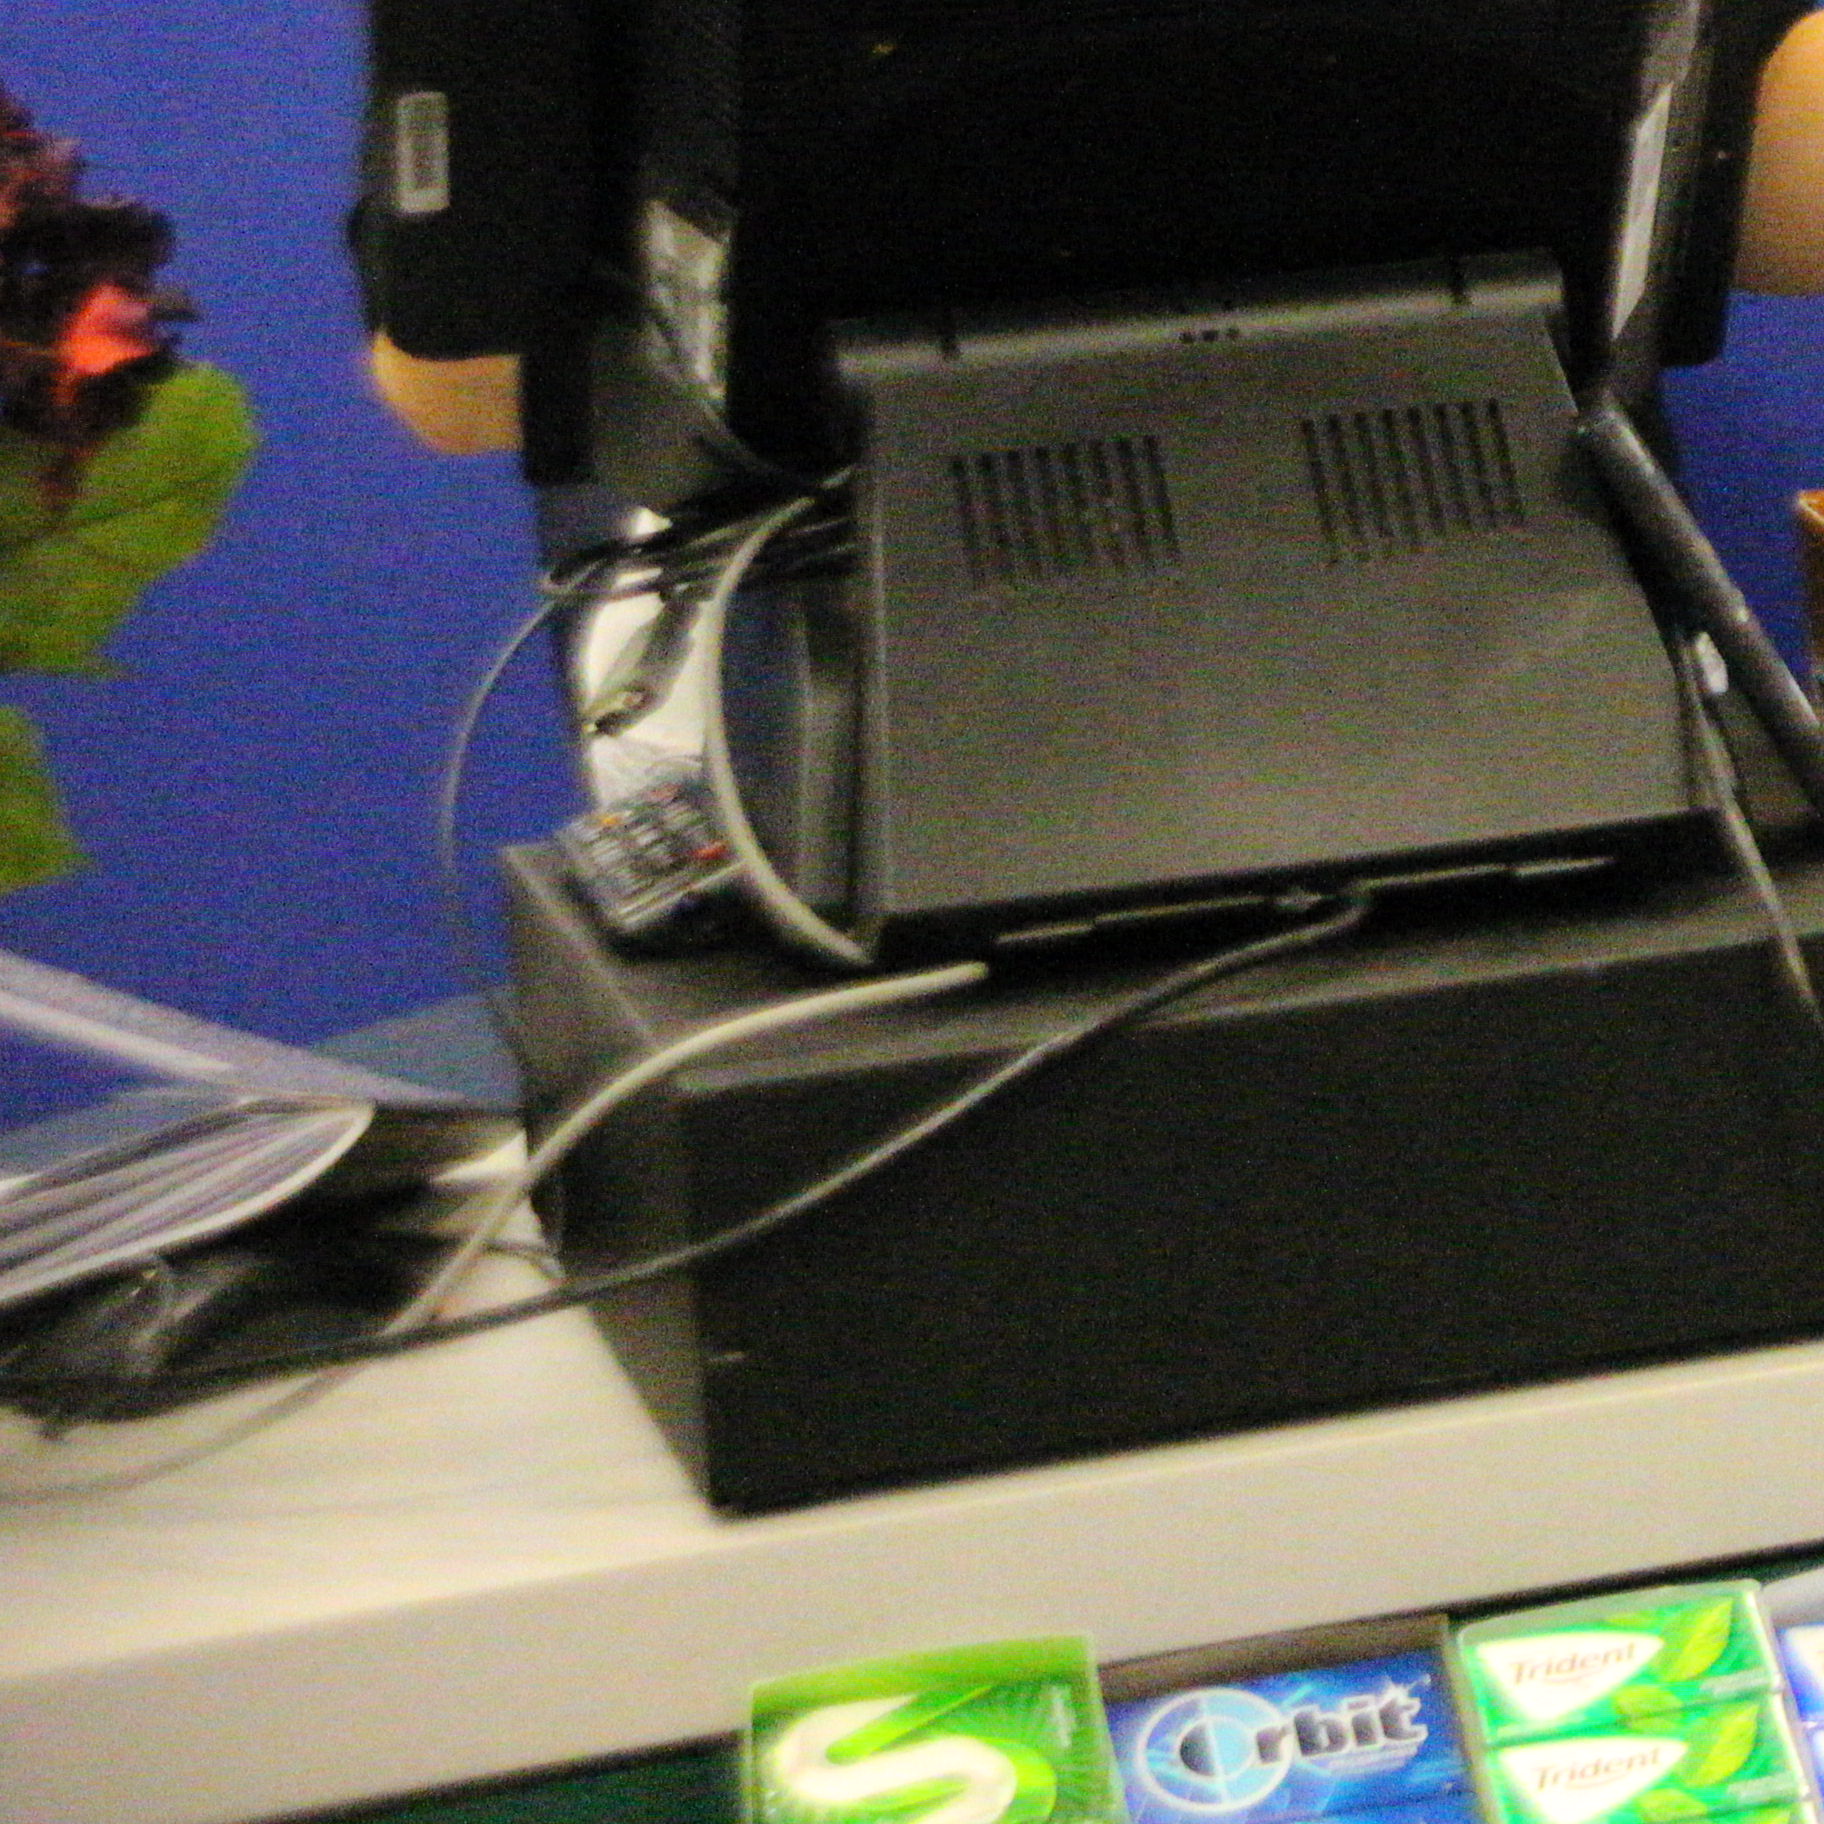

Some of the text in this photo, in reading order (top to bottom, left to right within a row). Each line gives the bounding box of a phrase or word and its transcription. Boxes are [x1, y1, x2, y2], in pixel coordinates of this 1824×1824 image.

[1508, 1642, 1637, 1686] Trident
[1138, 1686, 1430, 1813] Orbit
[1532, 1746, 1664, 1792] Trident
